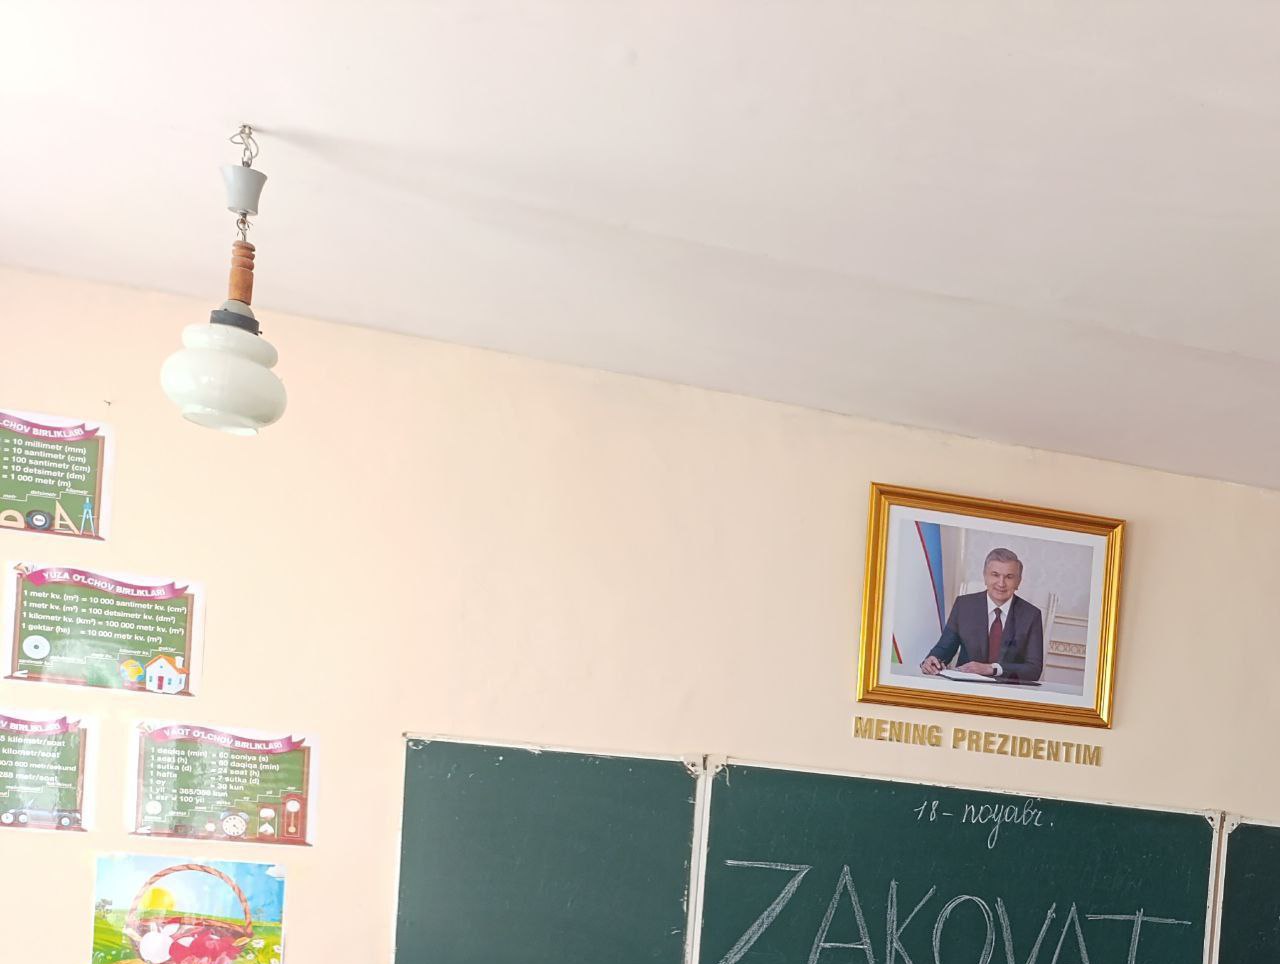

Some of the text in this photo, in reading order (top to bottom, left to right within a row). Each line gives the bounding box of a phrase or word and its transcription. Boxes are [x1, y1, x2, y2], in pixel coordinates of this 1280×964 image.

[0, 418, 84, 438] CHOV BIRLIKLARI
[24, 440, 63, 451] millimetr
[64, 444, 86, 456] (mm)
[24, 449, 66, 460] santimetr
[68, 454, 86, 464] (cm)
[23, 466, 64, 478] detsimetr
[66, 472, 86, 482] (dm)
[28, 458, 70, 470] santimetr
[72, 463, 90, 474] (cm)
[17, 474, 34, 482] 000
[35, 476, 56, 486] metr
[57, 480, 72, 488] (m)
[42, 571, 70, 580] YUZA
[116, 586, 166, 596] BIRLIKLARI
[116, 600, 153, 610] santimetr
[28, 612, 62, 622] kilometr
[106, 620, 119, 628] 100
[136, 624, 156, 632] metr
[104, 609, 142, 620] detsimetr
[853, 716, 1103, 768] MENING PREZIDENTIM
